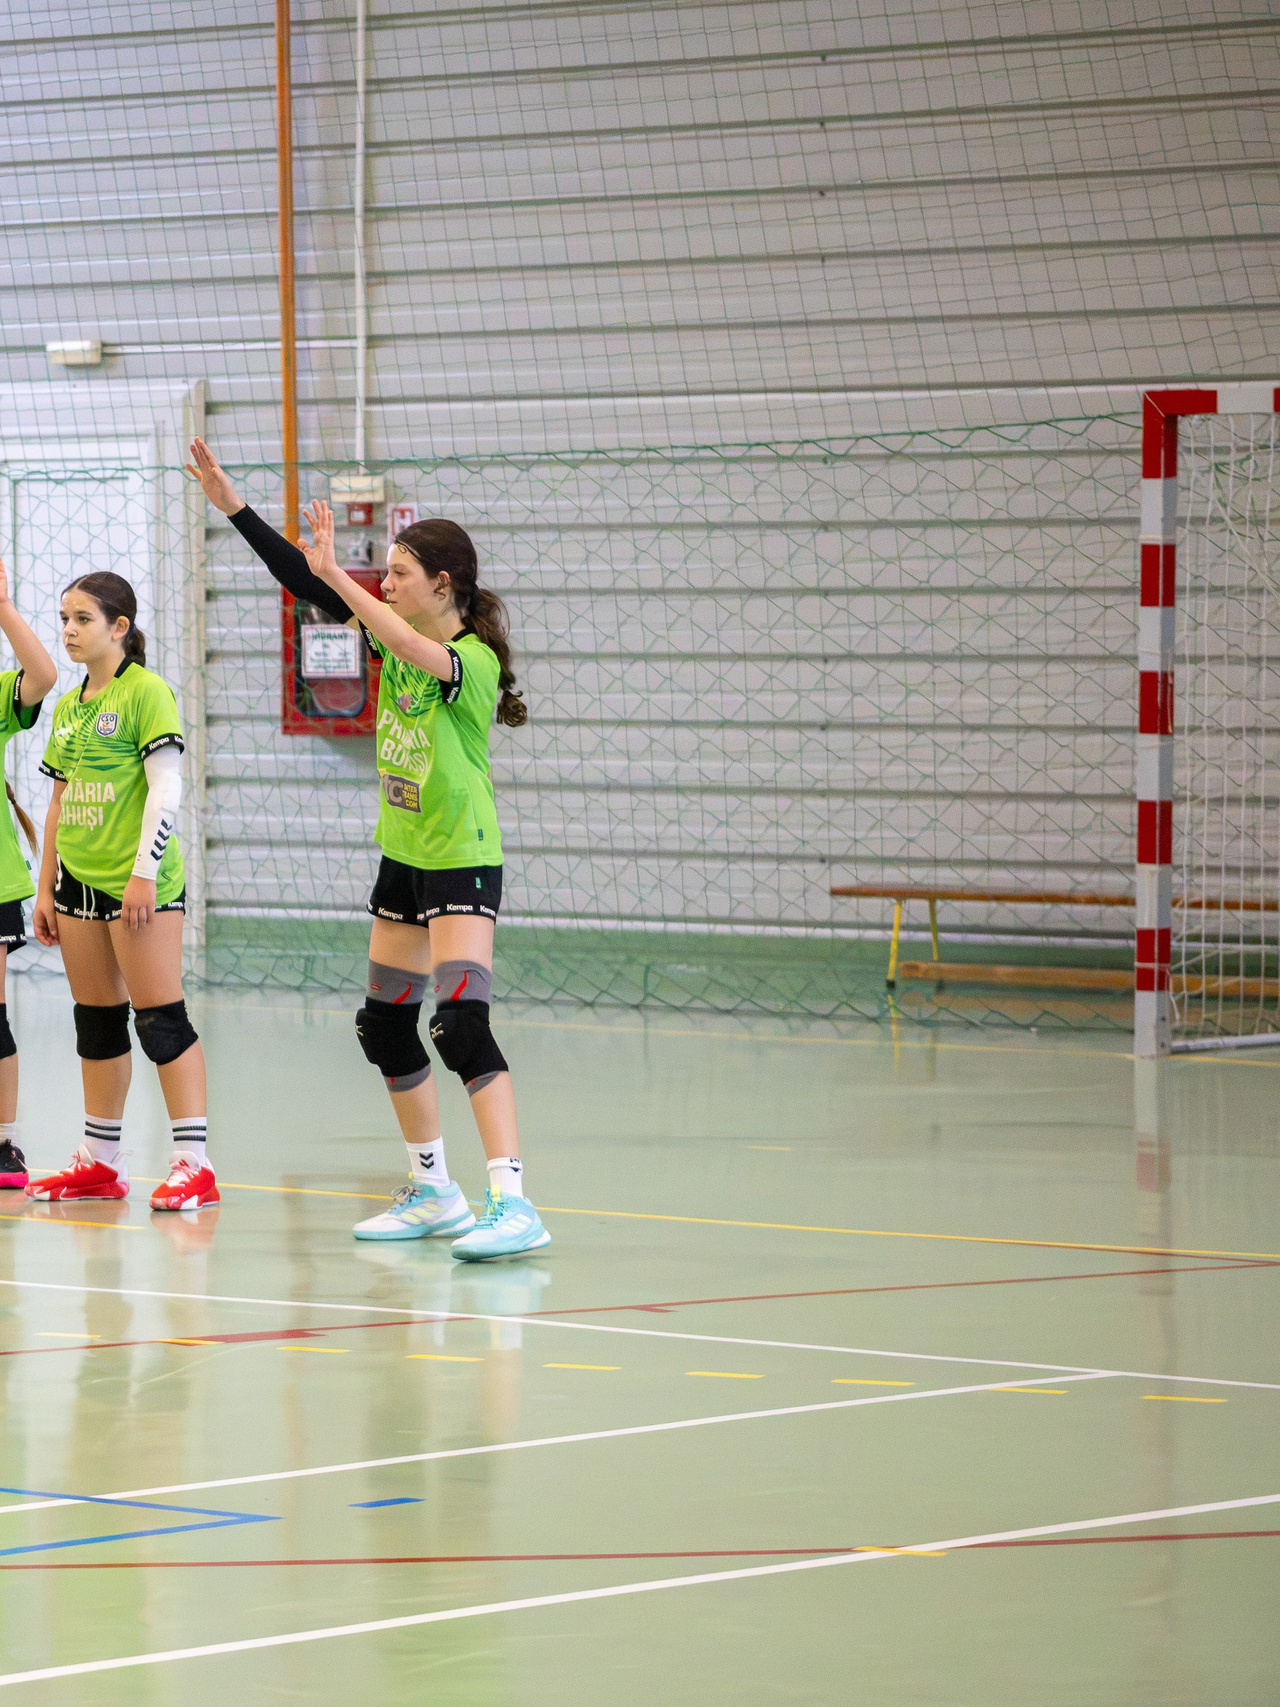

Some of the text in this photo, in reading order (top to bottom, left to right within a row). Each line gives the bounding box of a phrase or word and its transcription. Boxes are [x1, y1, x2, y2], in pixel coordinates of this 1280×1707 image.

[149, 736, 170, 751] Kempa
[378, 906, 404, 921] Kempa
[446, 903, 474, 913] Kempa
